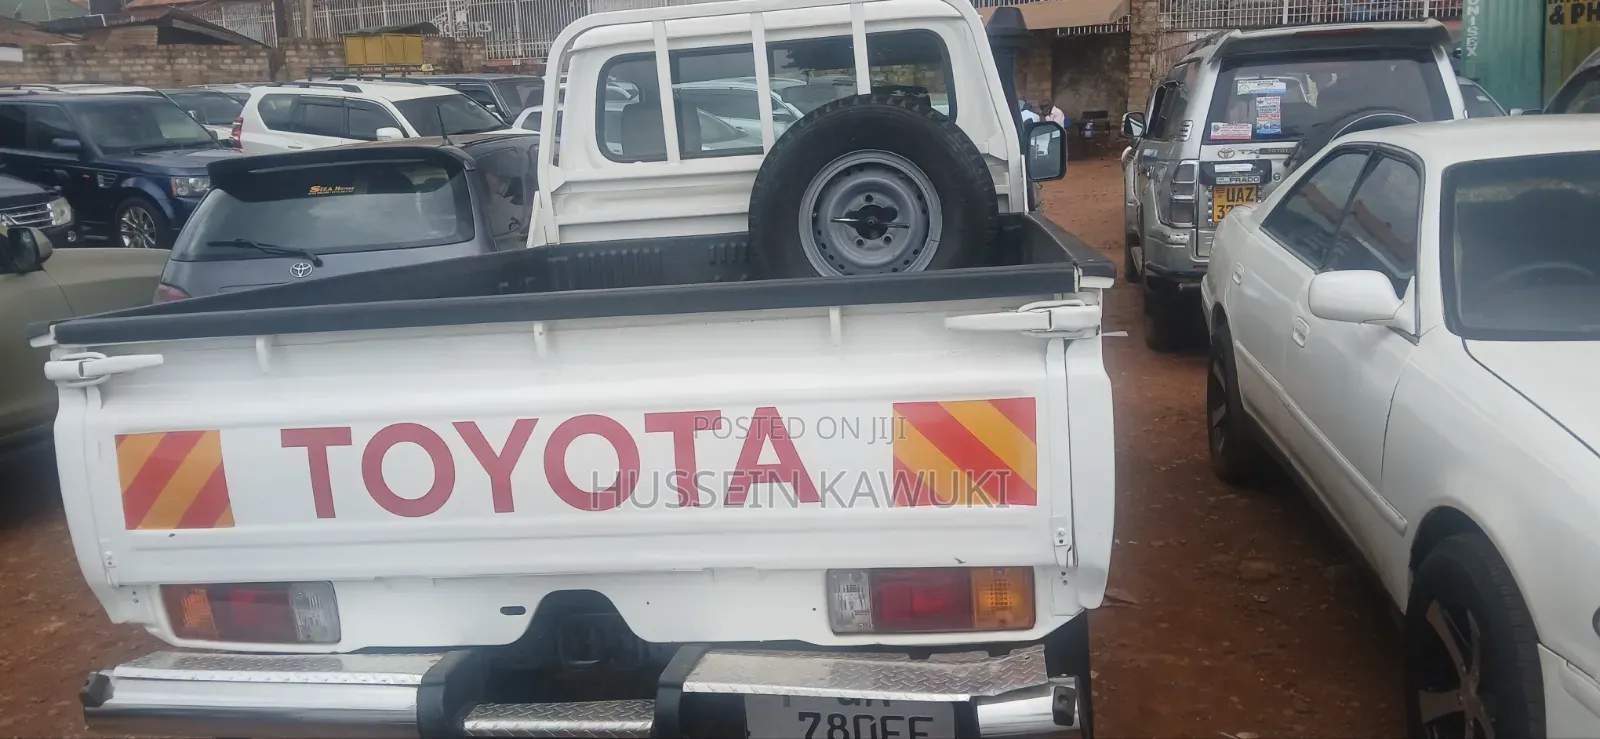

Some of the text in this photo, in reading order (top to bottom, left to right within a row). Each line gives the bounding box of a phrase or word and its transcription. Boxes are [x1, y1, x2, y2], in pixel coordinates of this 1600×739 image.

[1549, 4, 1565, 25] &
[1226, 187, 1254, 202] UAZ
[281, 406, 822, 519] TOYOTA
